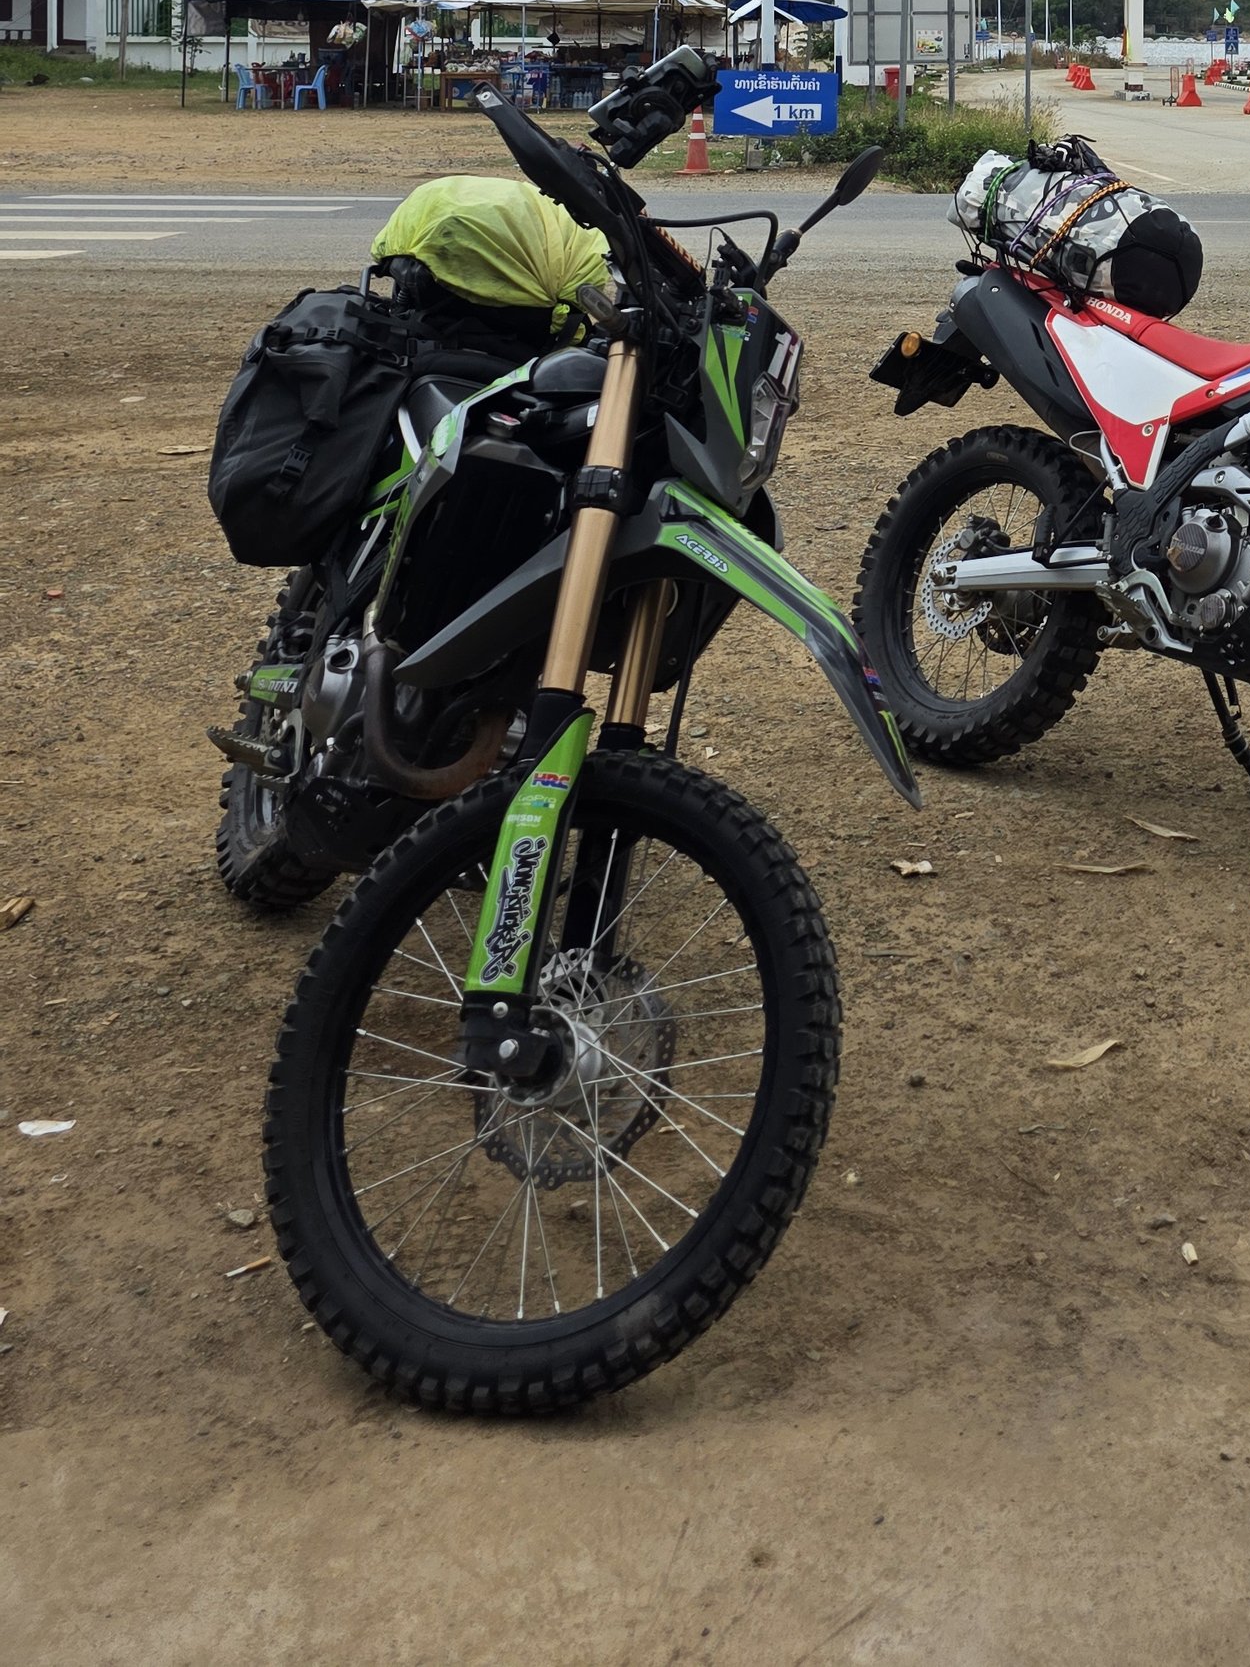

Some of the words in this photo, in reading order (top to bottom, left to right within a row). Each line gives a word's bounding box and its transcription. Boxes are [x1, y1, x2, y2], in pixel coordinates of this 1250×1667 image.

[773, 105, 781, 119] 1
[788, 105, 815, 119] km
[1086, 296, 1132, 325] HONDA
[531, 772, 571, 791] HRC
